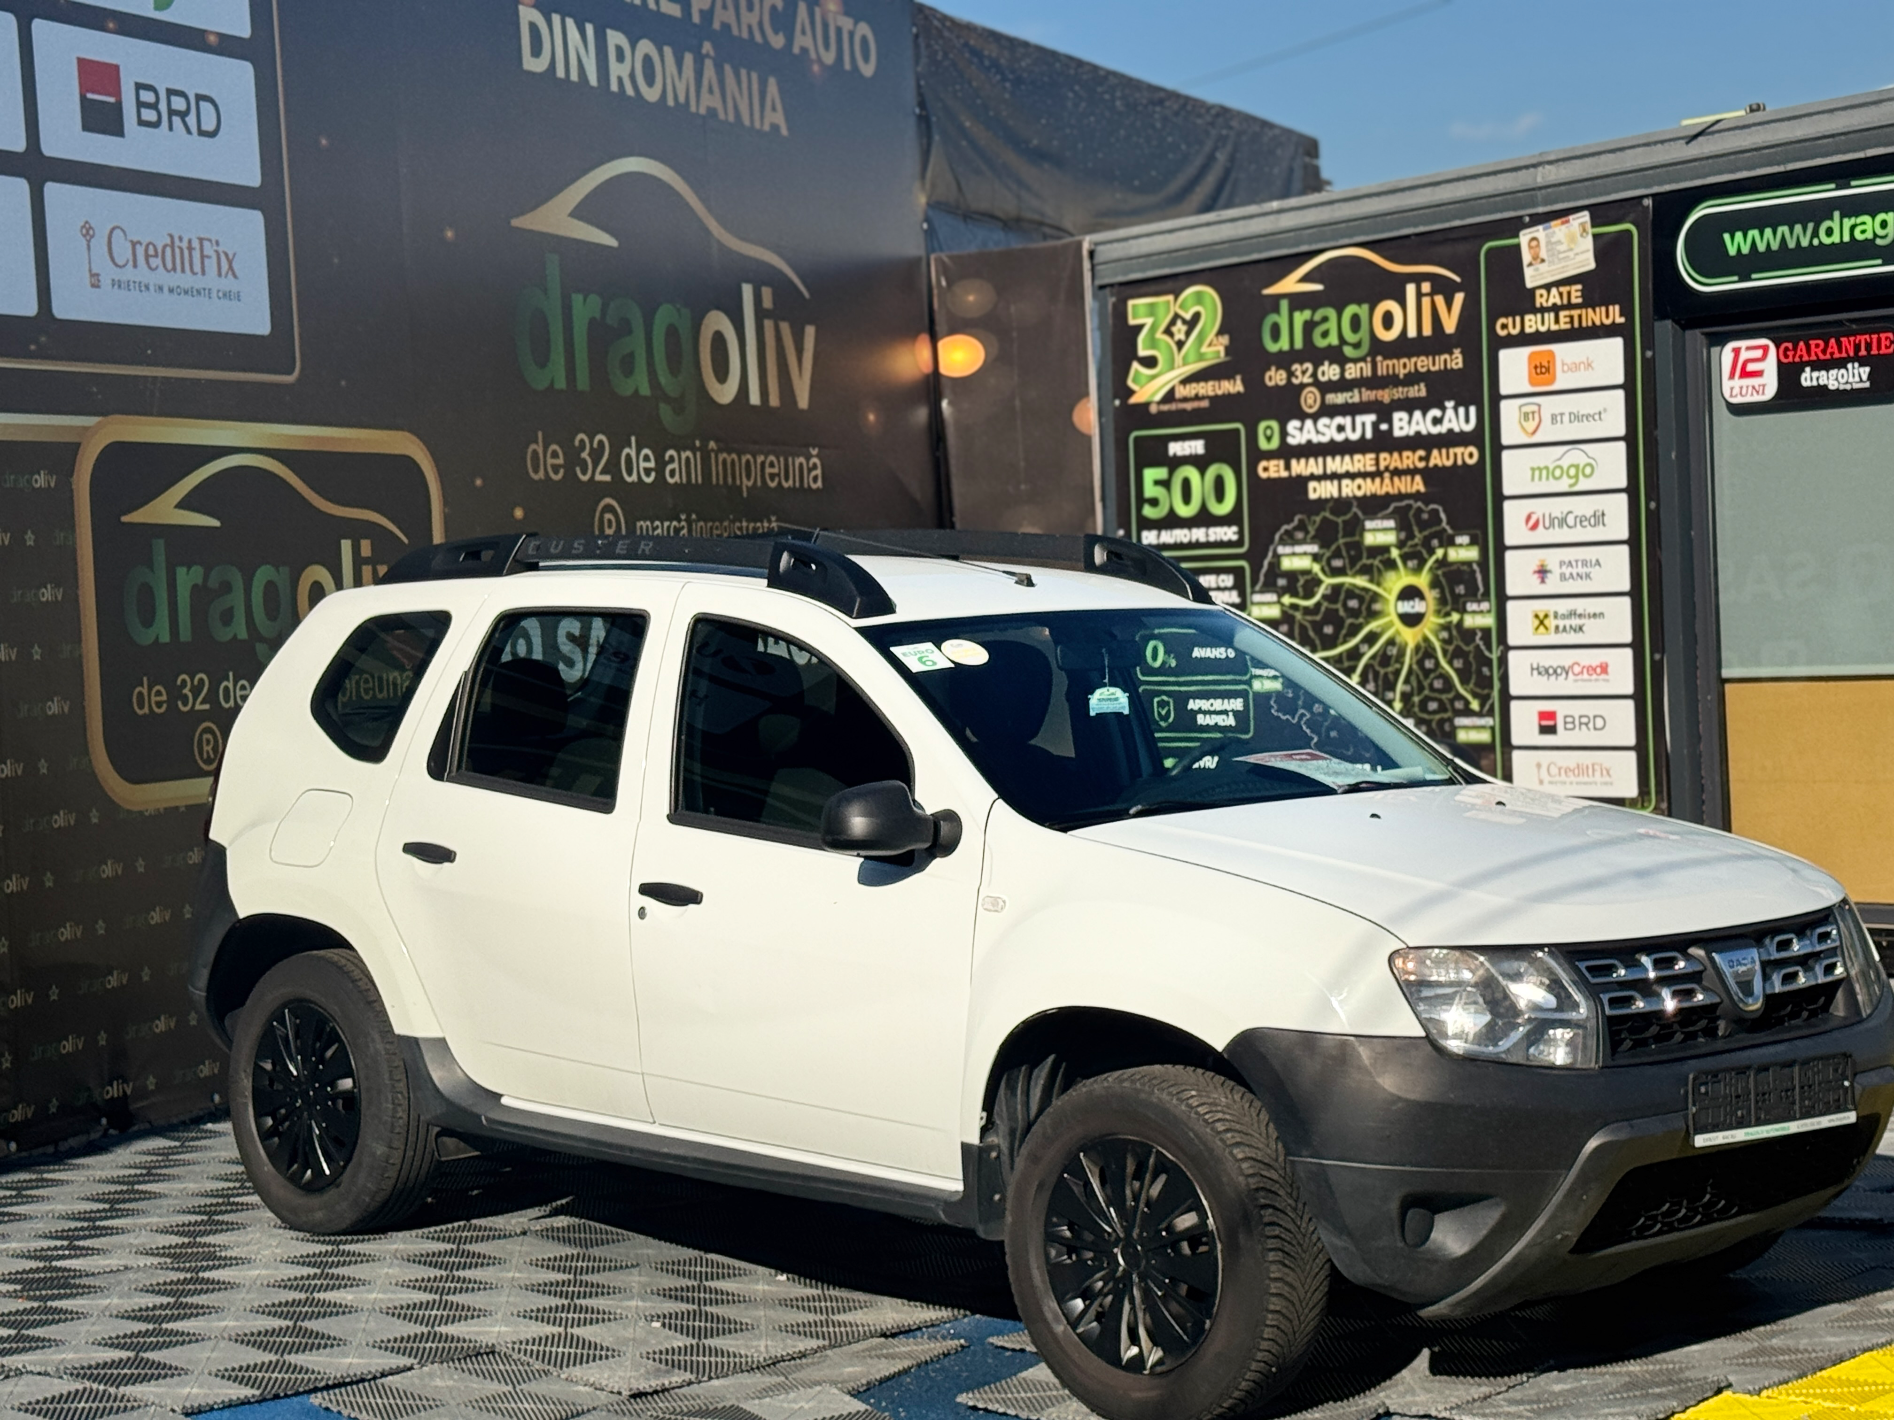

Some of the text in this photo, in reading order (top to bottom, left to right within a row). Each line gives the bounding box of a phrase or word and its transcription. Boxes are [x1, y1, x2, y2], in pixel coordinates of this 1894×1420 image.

[792, 2, 877, 78] AUTO
[518, 4, 788, 136] DIN ROMÂNIA
[134, 81, 221, 138] BRD
[107, 225, 238, 280] CreditFix
[111, 278, 241, 302] PRIETEN IN MOMENTE CHEIE
[1535, 284, 1582, 308] RATE
[1261, 281, 1465, 358] dragoliv
[1496, 305, 1625, 336] CU BULETINUL
[515, 253, 816, 435] dragoliv
[1779, 332, 1894, 363] GARANTIE
[1265, 349, 1463, 386] de 32 de ani împreună
[1534, 357, 1594, 376] tbi bank
[1728, 344, 1770, 380] 12
[1801, 362, 1870, 391] dragoliv
[1325, 387, 1360, 405] marcă
[1361, 383, 1426, 406] înregistrată
[1730, 384, 1766, 398] LUNI
[1286, 414, 1377, 445] SASCUT
[1393, 401, 1476, 438] BACĂU
[1523, 411, 1537, 423] BT
[1551, 413, 1566, 425] BT
[1168, 439, 1205, 457] PESTE
[527, 431, 823, 497] de 32 de ani împreună
[1257, 446, 1479, 479] CEL MAI MARE PARC AUTO
[1530, 462, 1595, 488] mogo
[1141, 462, 1237, 520] 500
[1308, 474, 1425, 500] DIN ROMÂNIA
[1543, 509, 1606, 531] UniCredit
[1141, 526, 1239, 545] DE AUTO PE STOC
[528, 540, 654, 555] USER
[1559, 558, 1601, 571] PATRIA
[1559, 570, 1592, 582] BANK
[1553, 609, 1605, 621] Raiffeisen
[1554, 623, 1585, 635] BANK
[917, 655, 938, 667] 6
[1192, 647, 1226, 659] AVANS
[1530, 662, 1609, 681] HappyCredit
[133, 677, 167, 715] de
[177, 674, 209, 712] 32
[219, 672, 250, 710] de
[1187, 698, 1243, 711] APROBARE
[1196, 711, 1236, 726] RAPIDĂ
[1563, 715, 1606, 732] BRD
[1547, 762, 1612, 778] CreditFix
